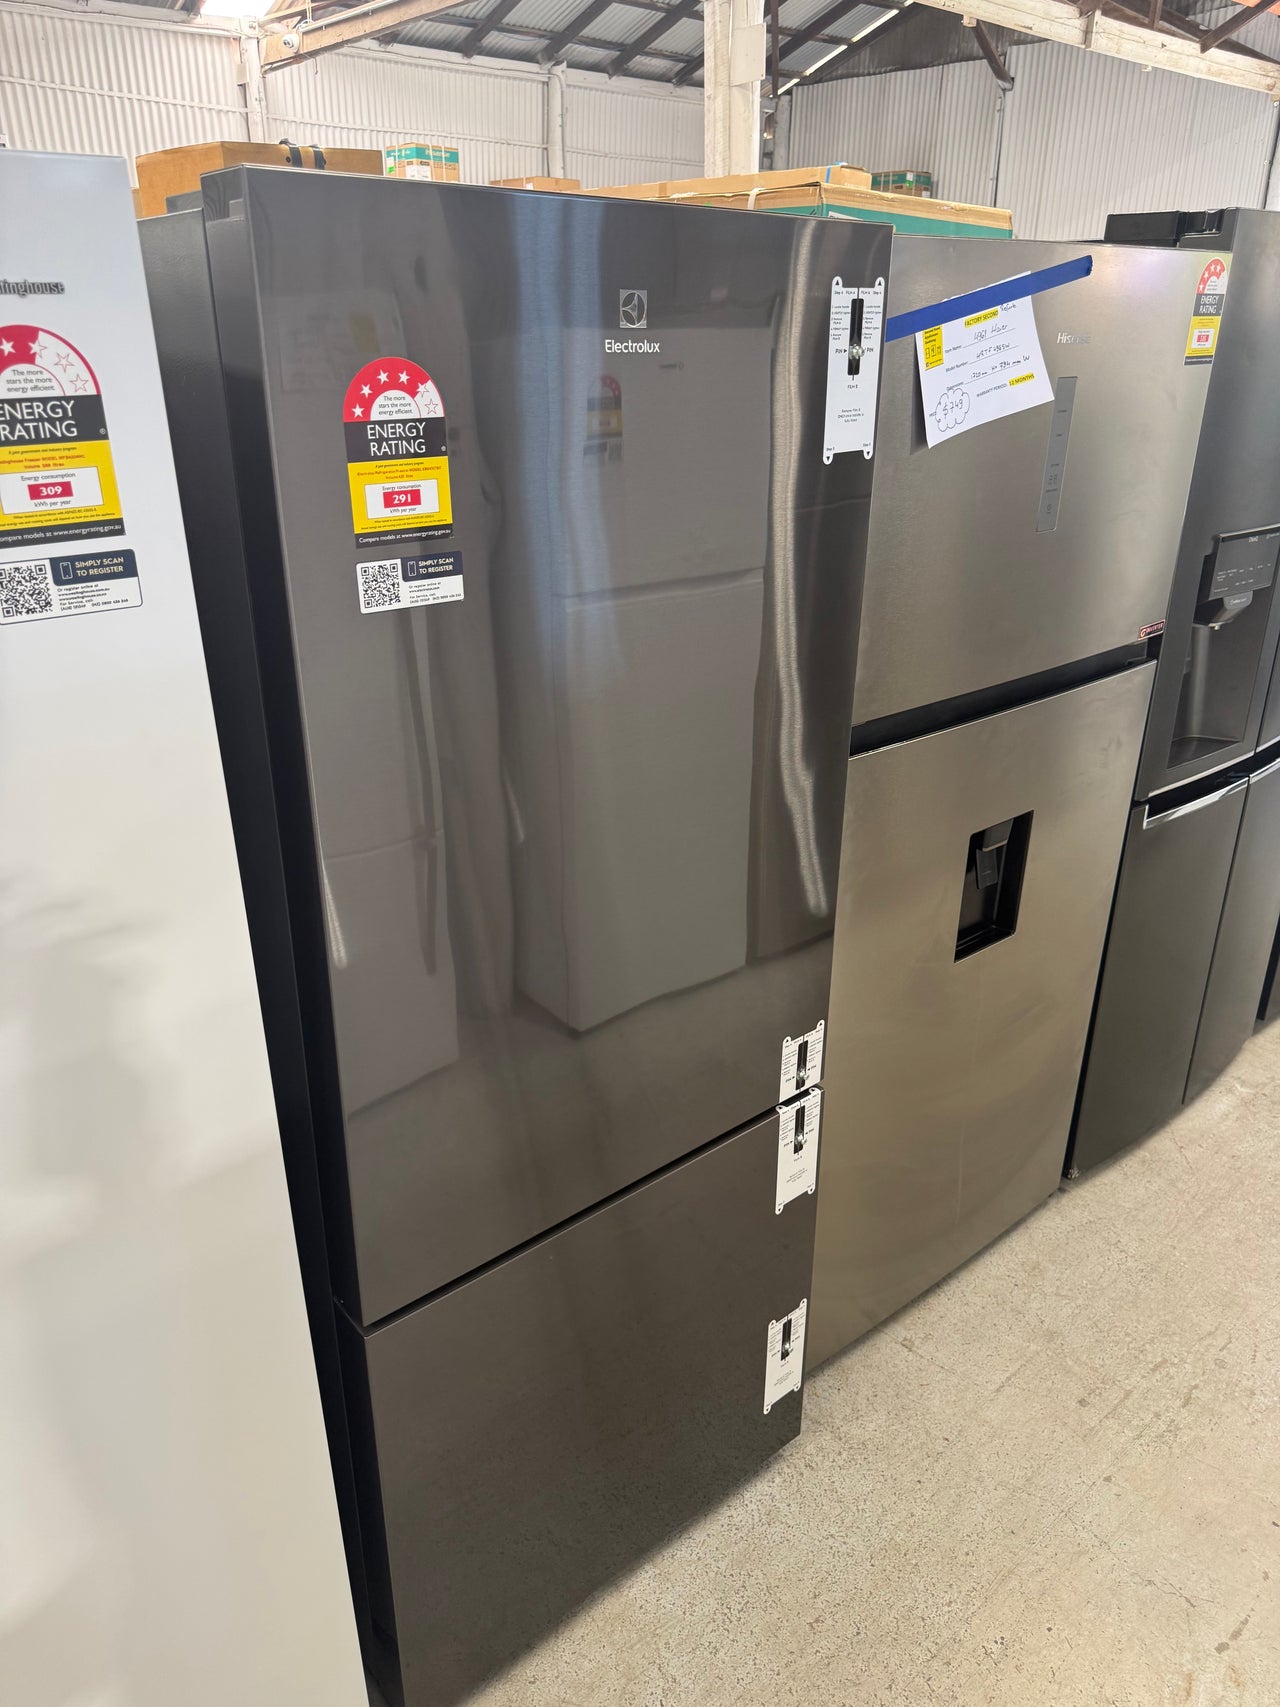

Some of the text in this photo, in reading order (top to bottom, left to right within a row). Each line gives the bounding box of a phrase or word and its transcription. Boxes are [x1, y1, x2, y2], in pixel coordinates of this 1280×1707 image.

[1200, 296, 1220, 304] ENERGY
[1199, 305, 1216, 314] RATING
[965, 310, 998, 326] FACTORY SECOND
[605, 340, 660, 353] Electrolux
[1015, 374, 1034, 383] MONTHS
[6, 386, 29, 394] energy
[0, 420, 78, 441] RATING
[367, 422, 426, 439] ENERGY
[370, 439, 426, 456] RATING
[41, 472, 76, 480] consumption
[40, 486, 62, 496] 309
[392, 494, 411, 504] 291
[23, 532, 45, 540] models
[53, 524, 122, 536] www.energyrating.gov.au
[75, 557, 124, 568] SIMPLY SCAN
[89, 565, 124, 575] REGISTER
